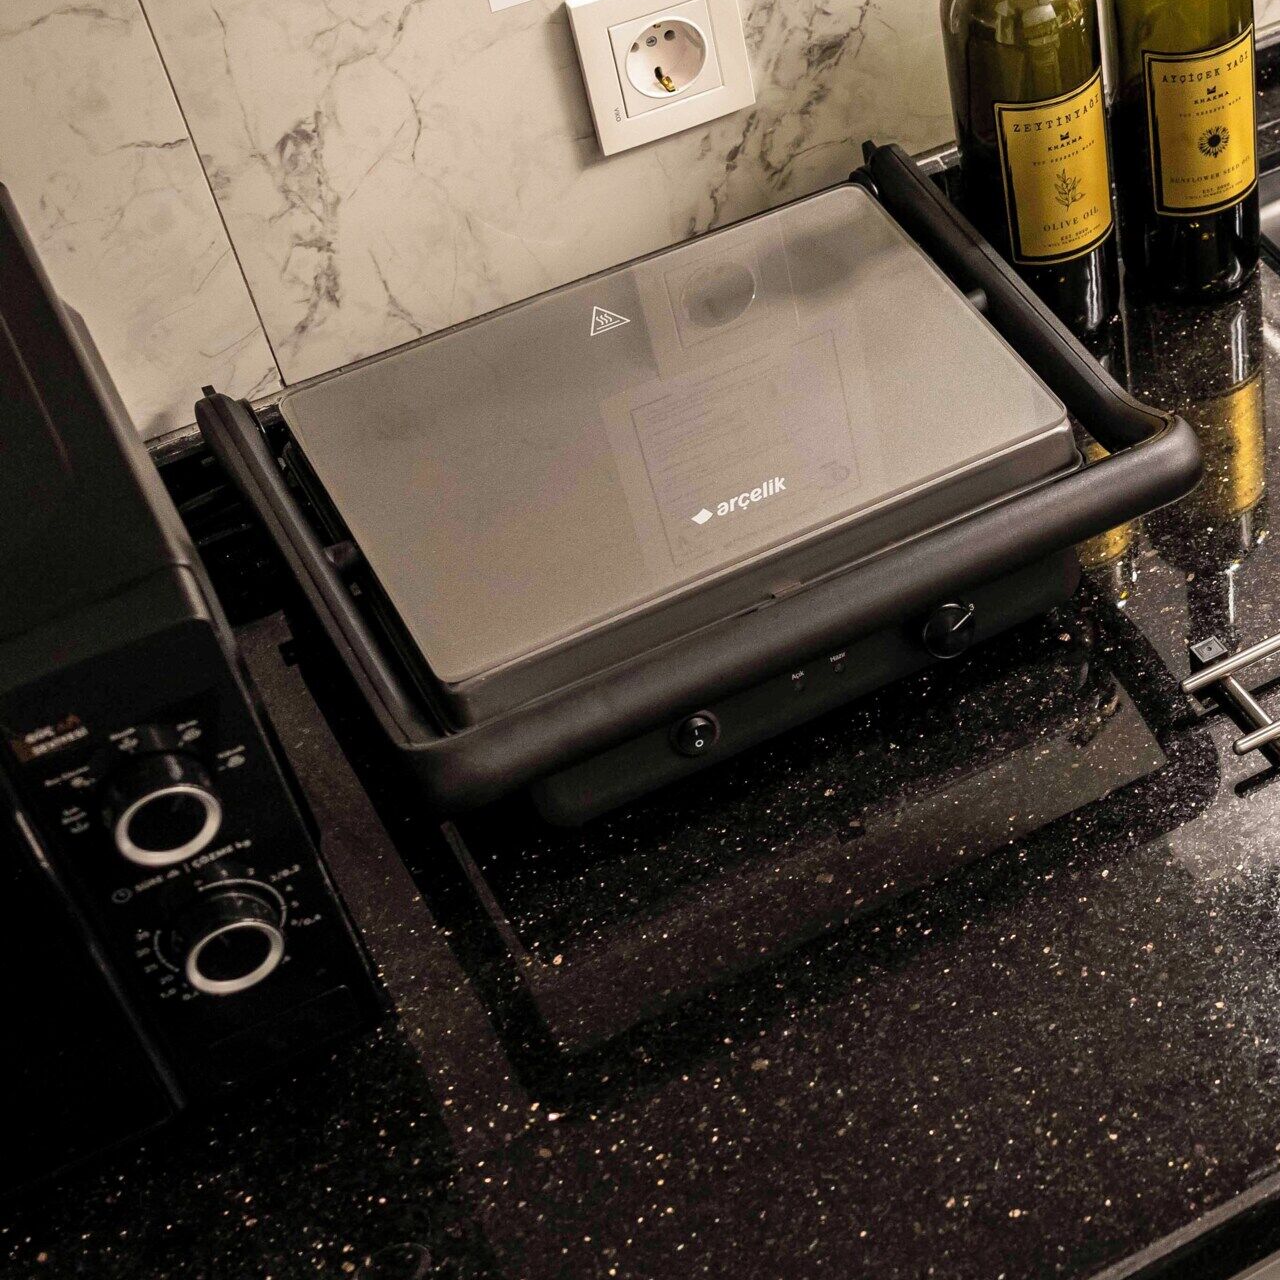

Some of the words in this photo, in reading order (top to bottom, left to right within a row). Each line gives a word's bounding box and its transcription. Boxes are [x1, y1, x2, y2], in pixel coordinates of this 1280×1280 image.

[1043, 216, 1079, 232] OLIVE
[1083, 205, 1099, 220] OIL
[717, 476, 787, 517] arçelik
